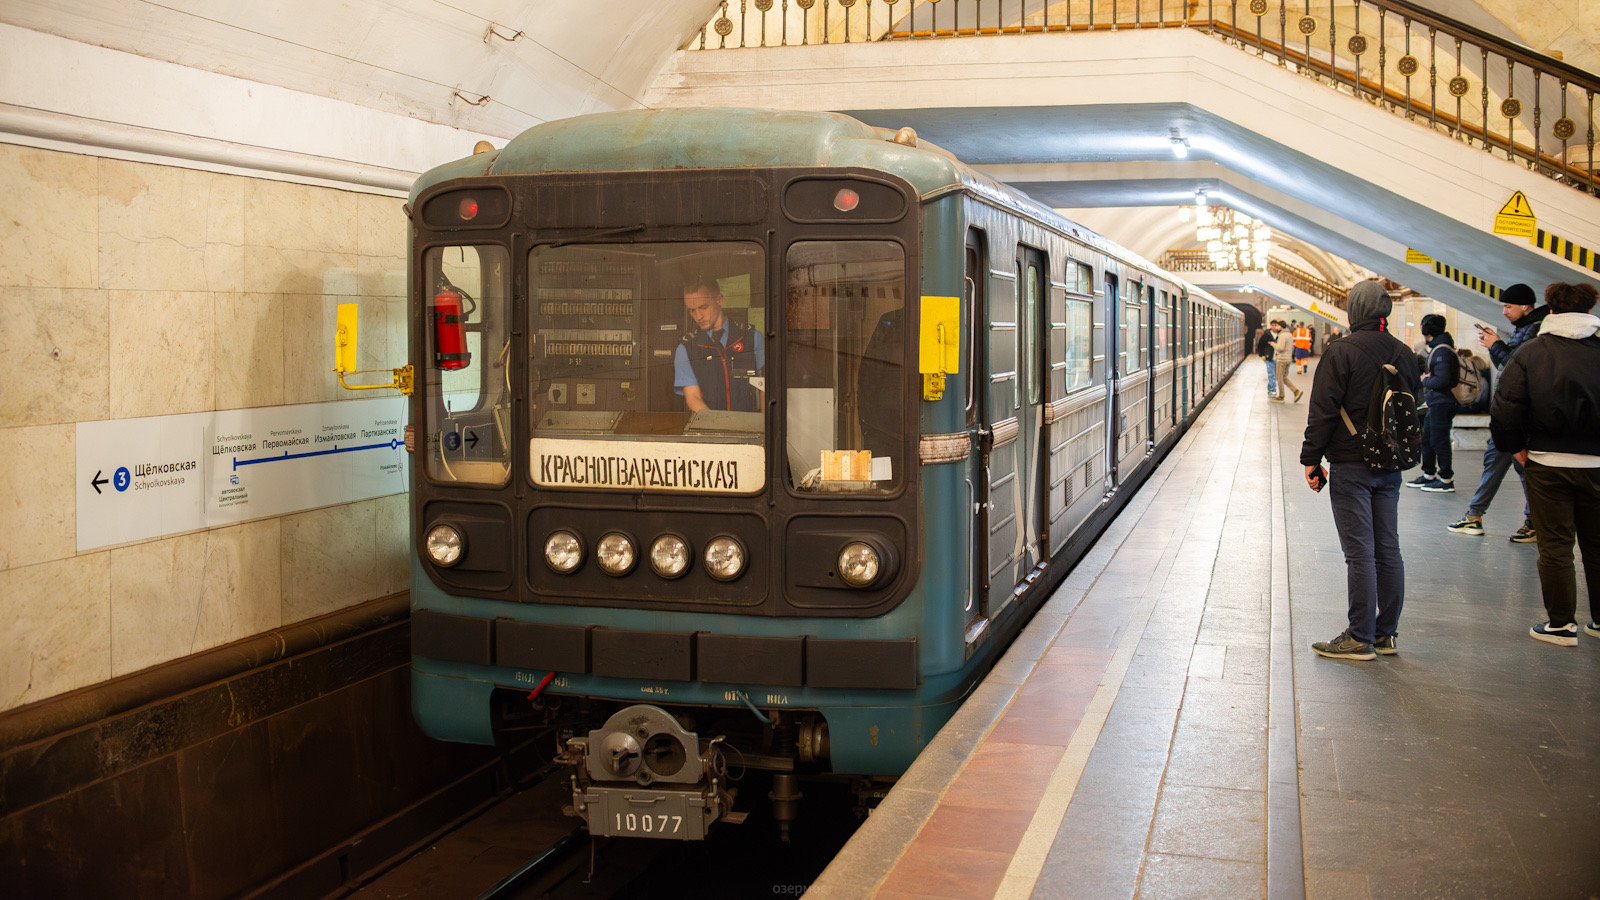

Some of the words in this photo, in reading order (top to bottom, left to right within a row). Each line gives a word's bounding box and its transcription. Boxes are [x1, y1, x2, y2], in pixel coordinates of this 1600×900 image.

[1496, 225, 1532, 233] ПРЕПЯТСТВИЕ
[216, 433, 252, 443] Schyolkovskaya
[270, 428, 302, 437] Pervomayskaya
[212, 443, 256, 456] Щёлковская
[262, 436, 310, 450] Первомайская
[314, 432, 357, 443] Измайловская
[360, 428, 397, 439] Партизанская
[135, 460, 196, 478] Щёлковская
[540, 454, 739, 490] КРАСНОГВАРДЕЙСКАЯ
[134, 476, 185, 491] Schyolkovskaya
[615, 813, 683, 834] 10077
